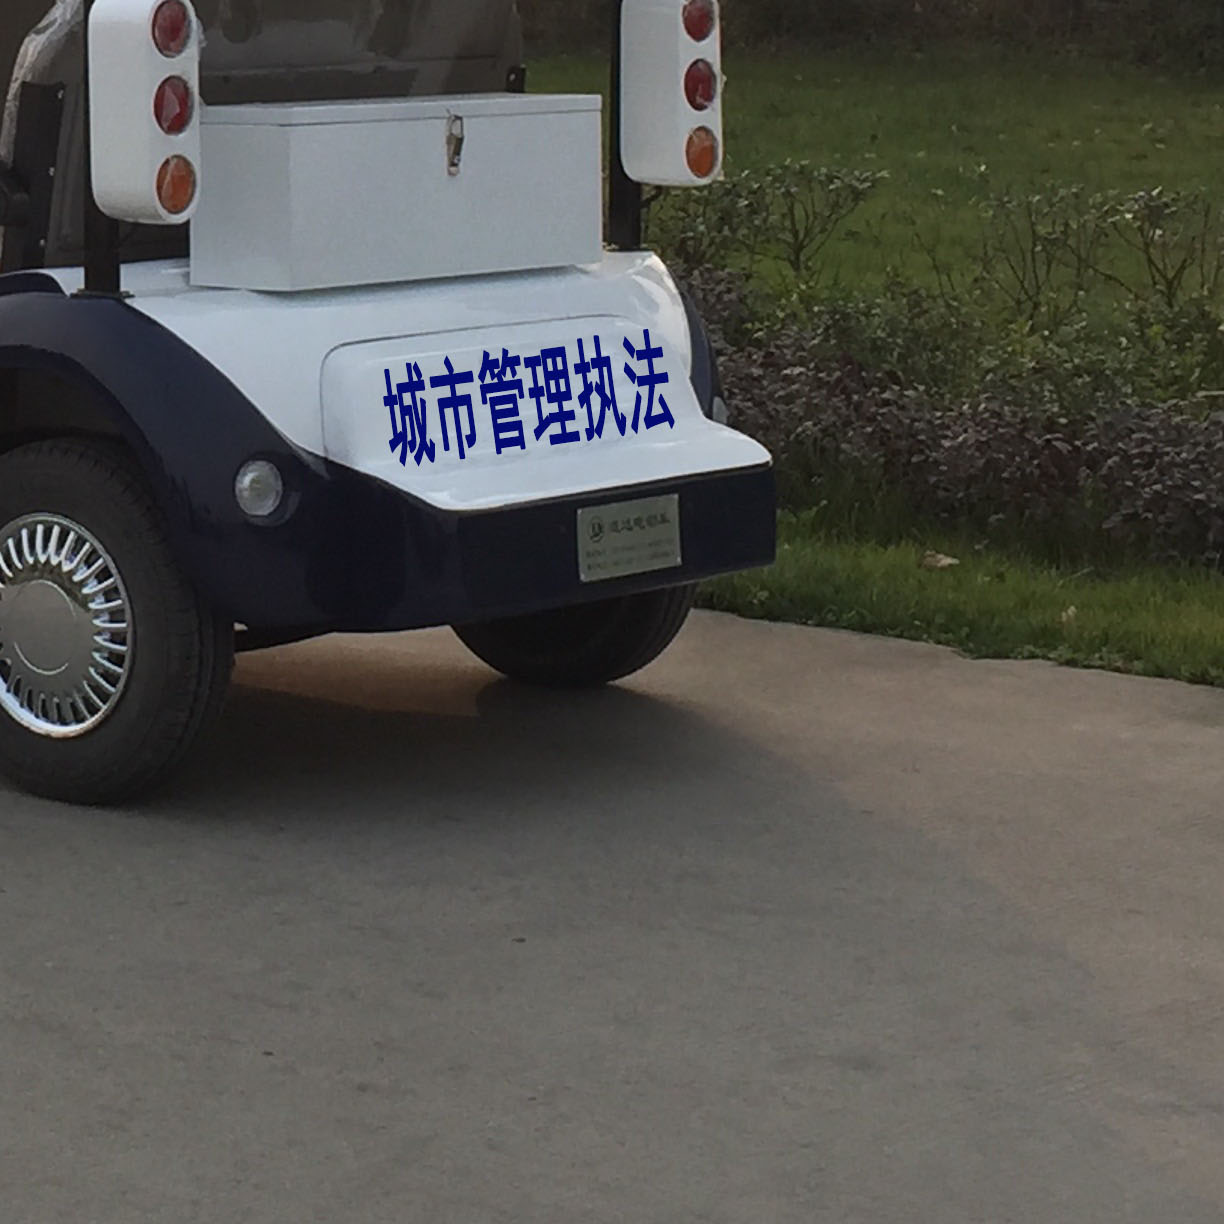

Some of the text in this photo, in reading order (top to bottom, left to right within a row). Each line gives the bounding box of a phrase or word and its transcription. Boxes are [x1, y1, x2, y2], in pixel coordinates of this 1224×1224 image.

[383, 328, 675, 467] 城市管理执法
